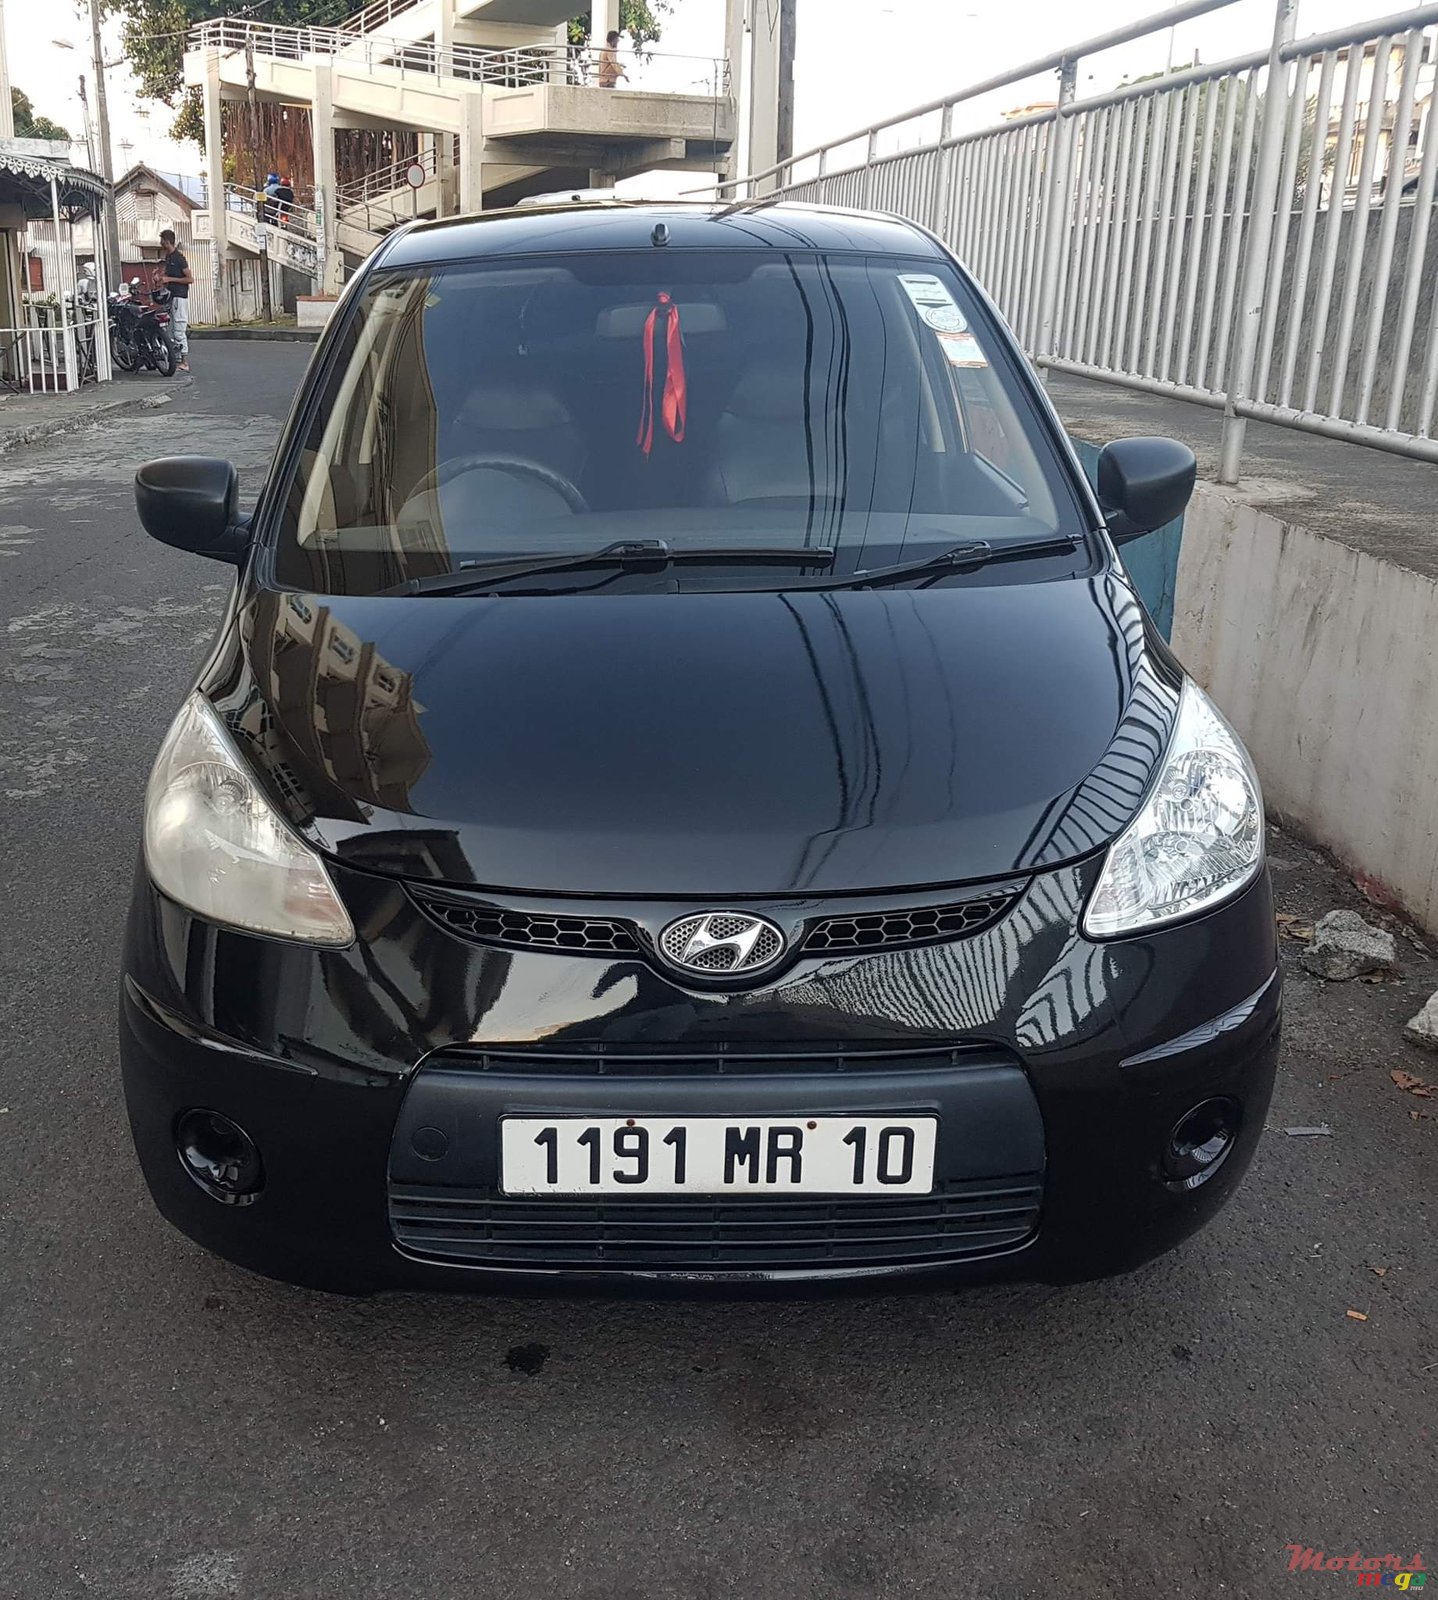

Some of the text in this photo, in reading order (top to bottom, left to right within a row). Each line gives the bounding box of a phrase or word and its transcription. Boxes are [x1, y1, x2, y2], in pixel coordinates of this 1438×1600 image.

[534, 1126, 916, 1184] 1191 MR 10
